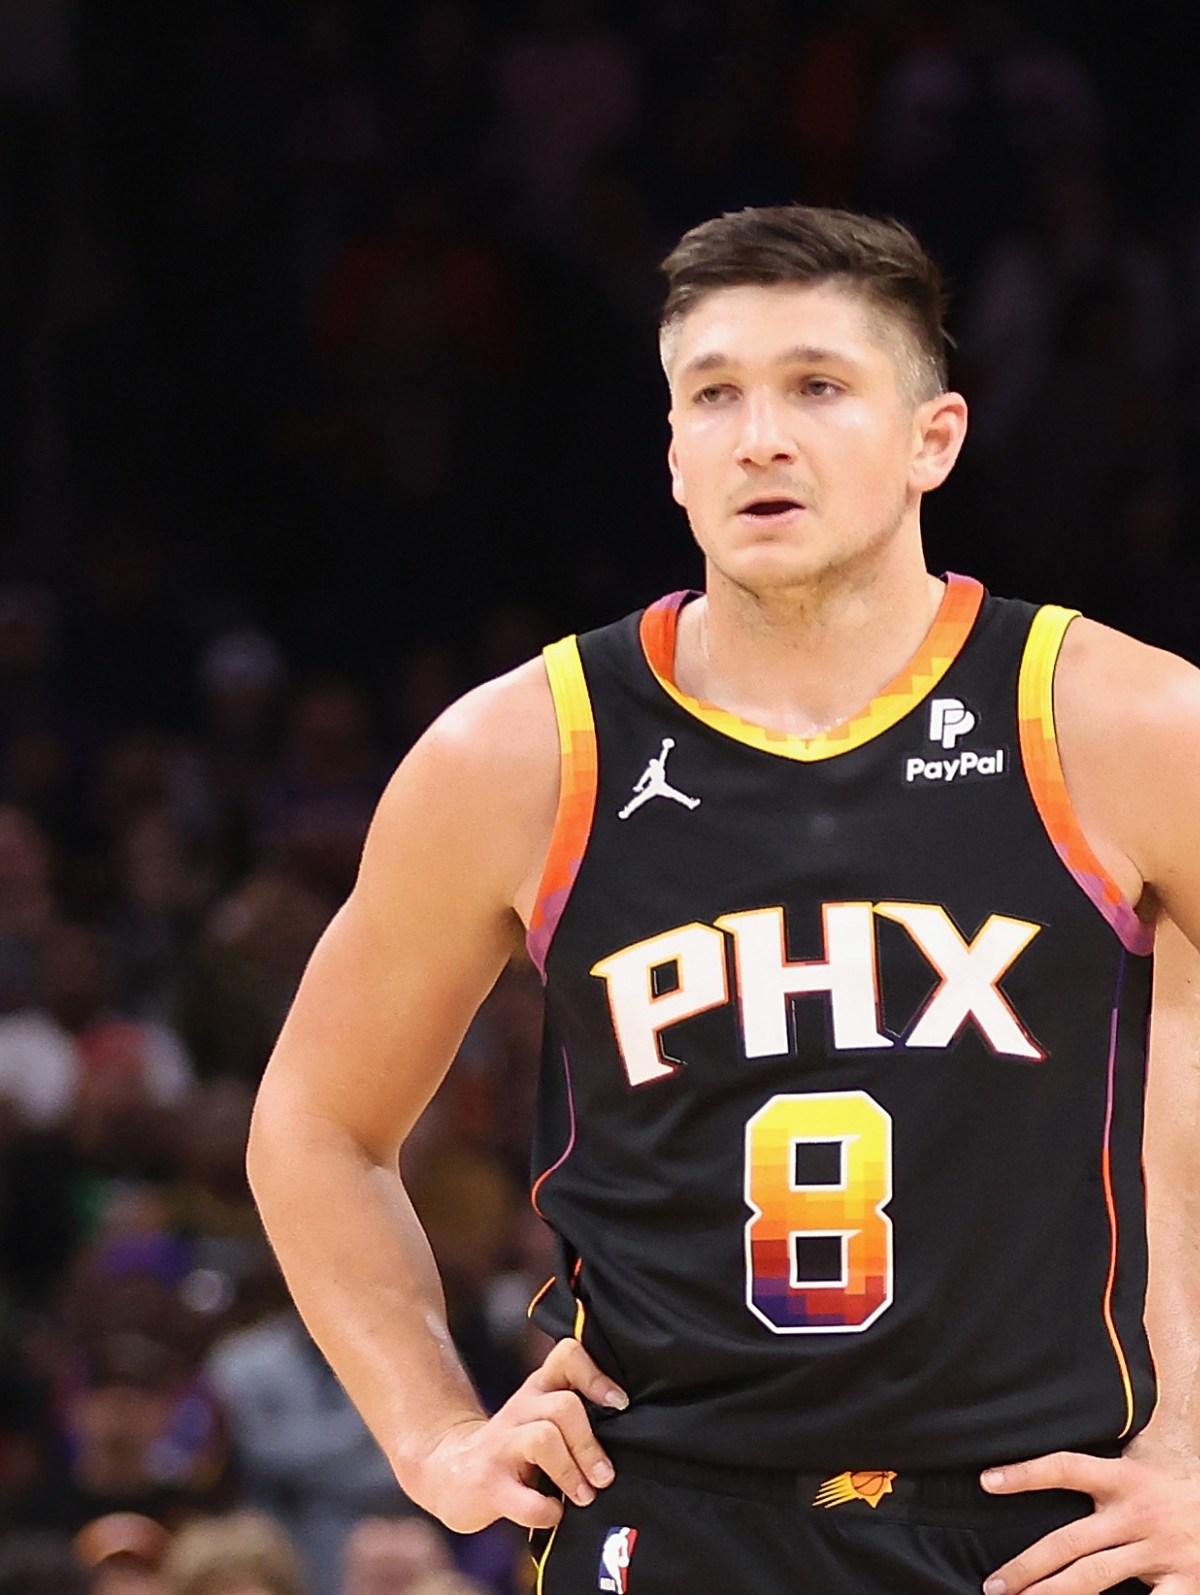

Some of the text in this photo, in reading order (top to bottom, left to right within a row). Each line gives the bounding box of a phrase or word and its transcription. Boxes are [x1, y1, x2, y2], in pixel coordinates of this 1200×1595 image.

[906, 749, 1004, 782] PayPal
[590, 902, 1048, 1087] PHX
[744, 1090, 894, 1334] 8
